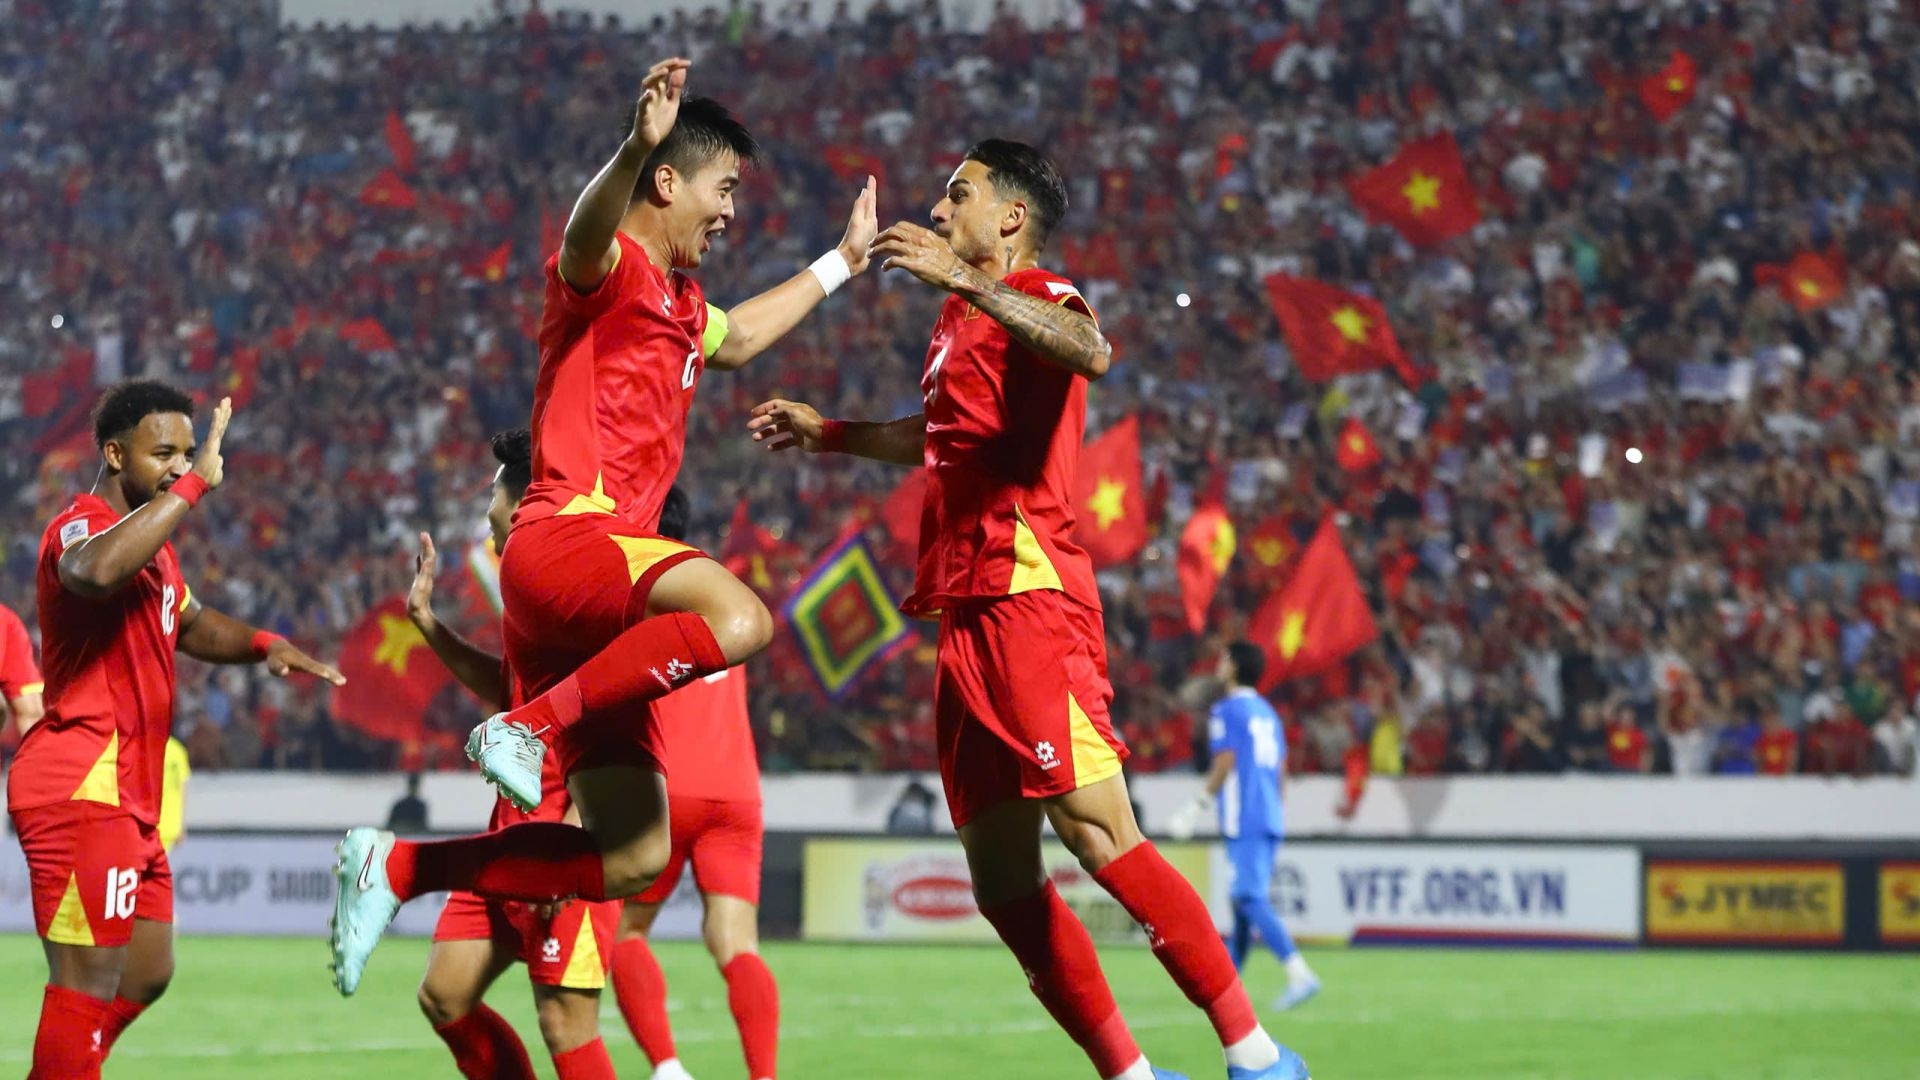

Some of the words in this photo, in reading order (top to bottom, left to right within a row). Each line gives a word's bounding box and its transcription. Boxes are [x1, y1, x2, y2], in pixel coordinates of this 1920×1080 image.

[161, 583, 175, 636] 12
[104, 866, 138, 920] 12
[174, 867, 251, 902] CUP
